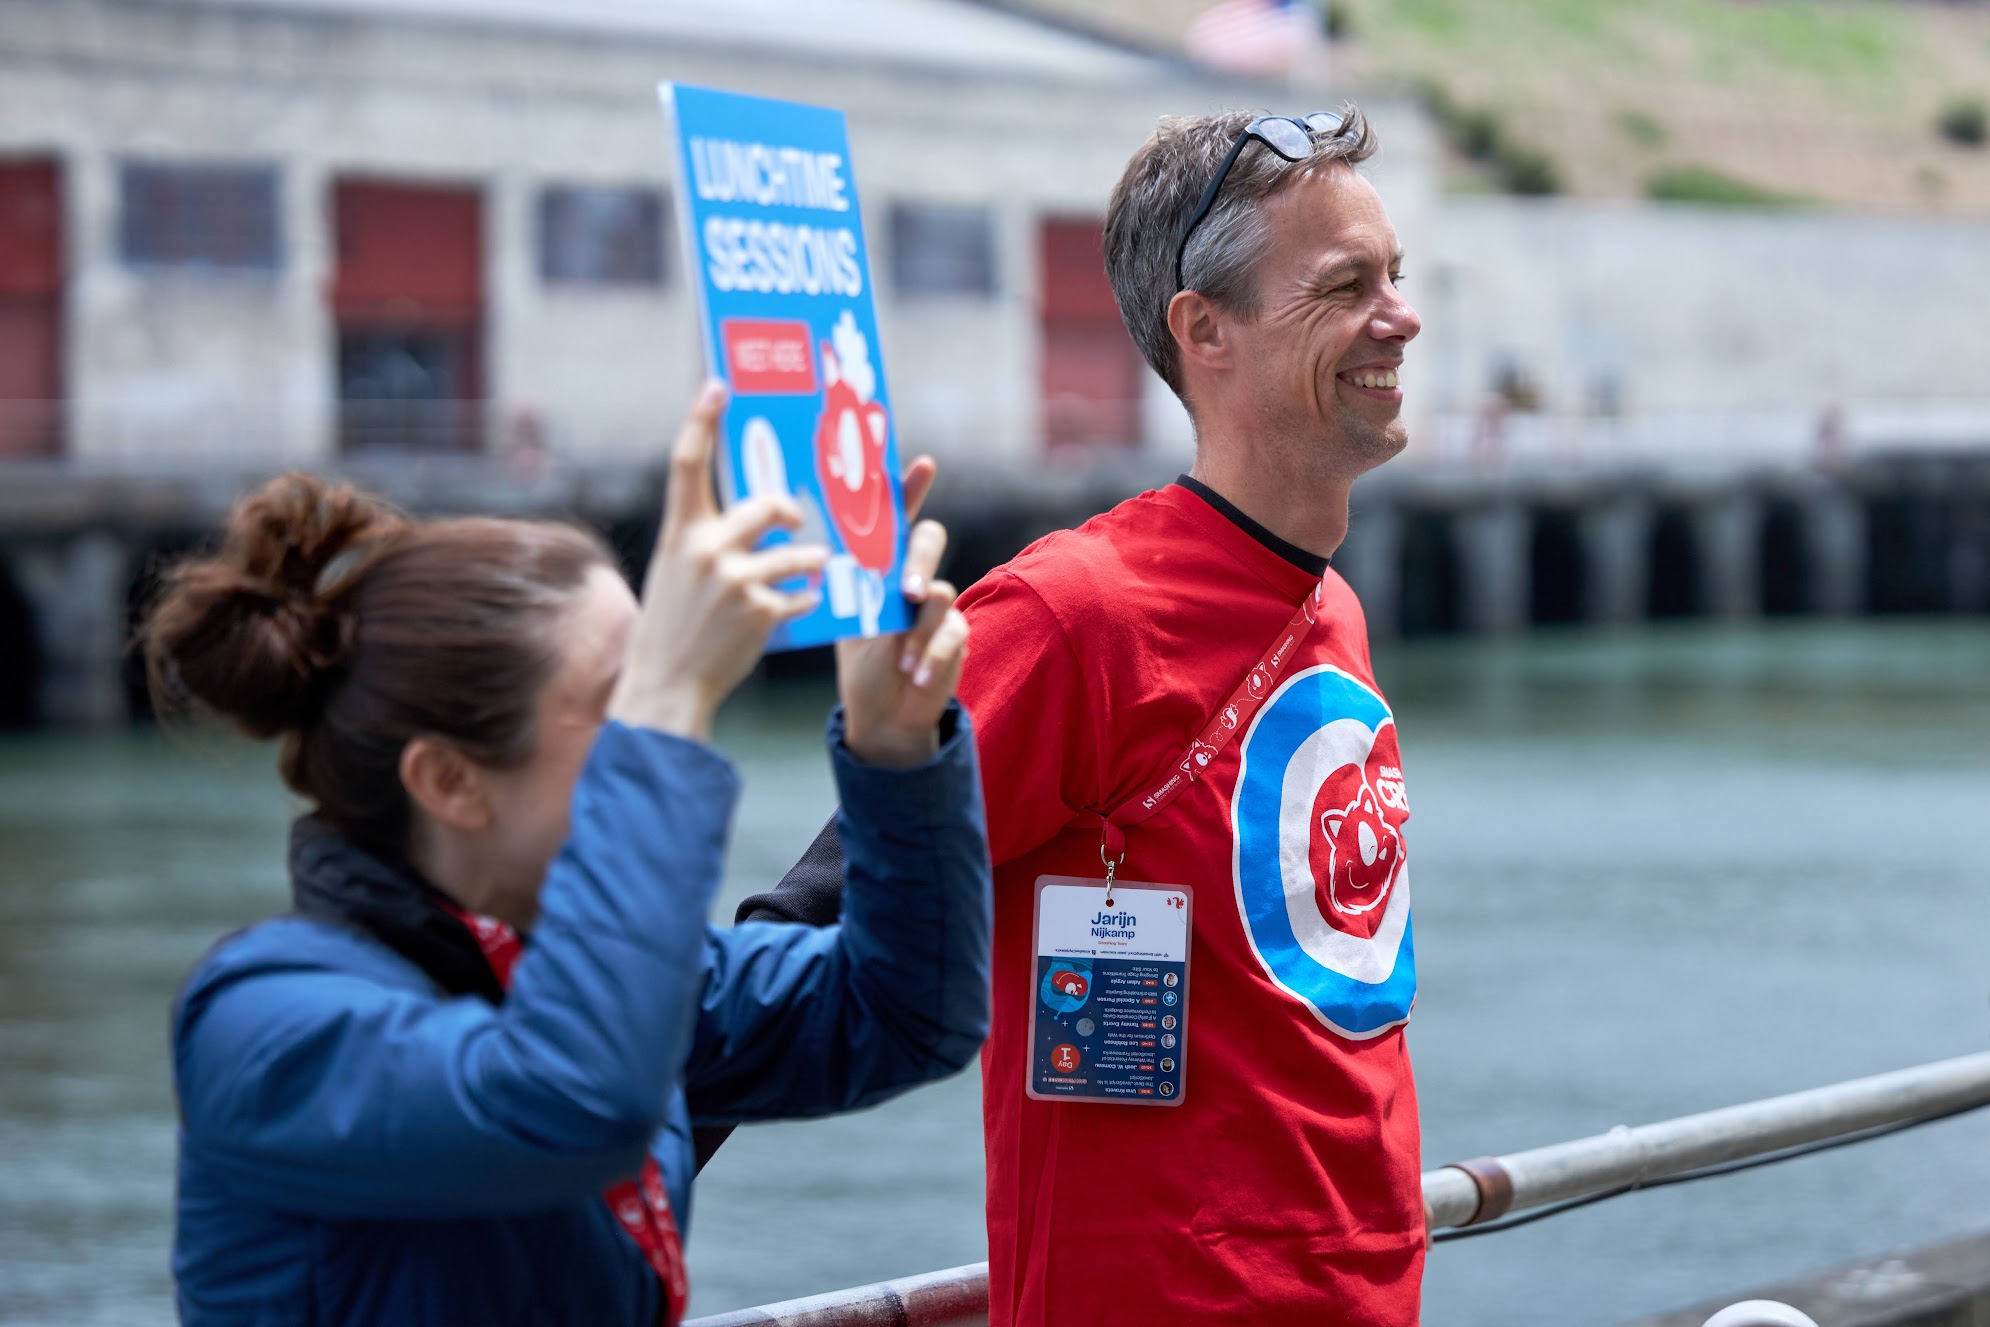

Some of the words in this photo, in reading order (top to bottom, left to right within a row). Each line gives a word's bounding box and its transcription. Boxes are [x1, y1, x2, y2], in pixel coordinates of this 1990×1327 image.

[690, 136, 850, 211] LUNCHTIME
[704, 217, 862, 297] SESSIONS
[1154, 774, 1180, 798] SMASHING
[1091, 912, 1136, 928] Jarijn
[1092, 928, 1135, 939] Nijkamp
[1061, 1048, 1071, 1060] 1
